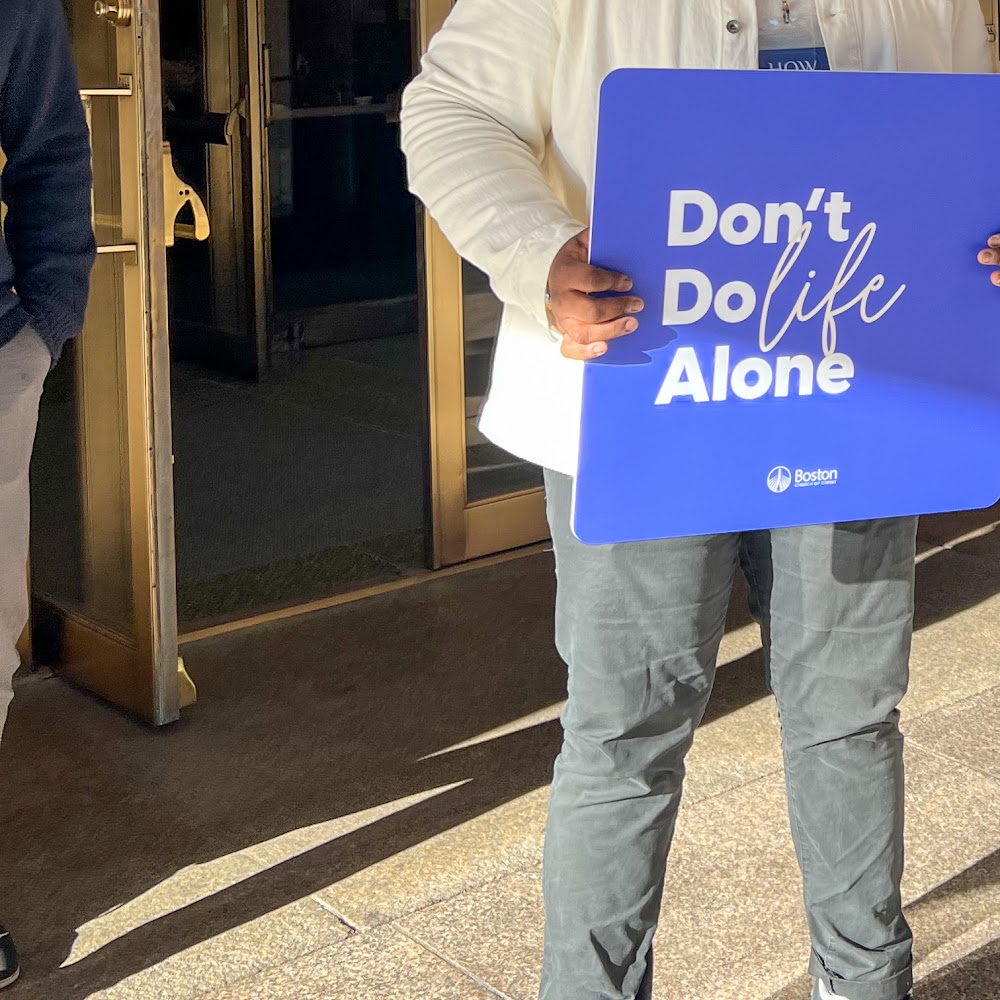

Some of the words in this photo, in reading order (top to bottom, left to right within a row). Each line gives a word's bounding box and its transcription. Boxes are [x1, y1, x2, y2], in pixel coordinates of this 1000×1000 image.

[667, 187, 851, 247] Don't
[662, 268, 757, 326] Do
[758, 221, 906, 358] life
[654, 344, 855, 405] Alone
[794, 468, 838, 483] Boston
